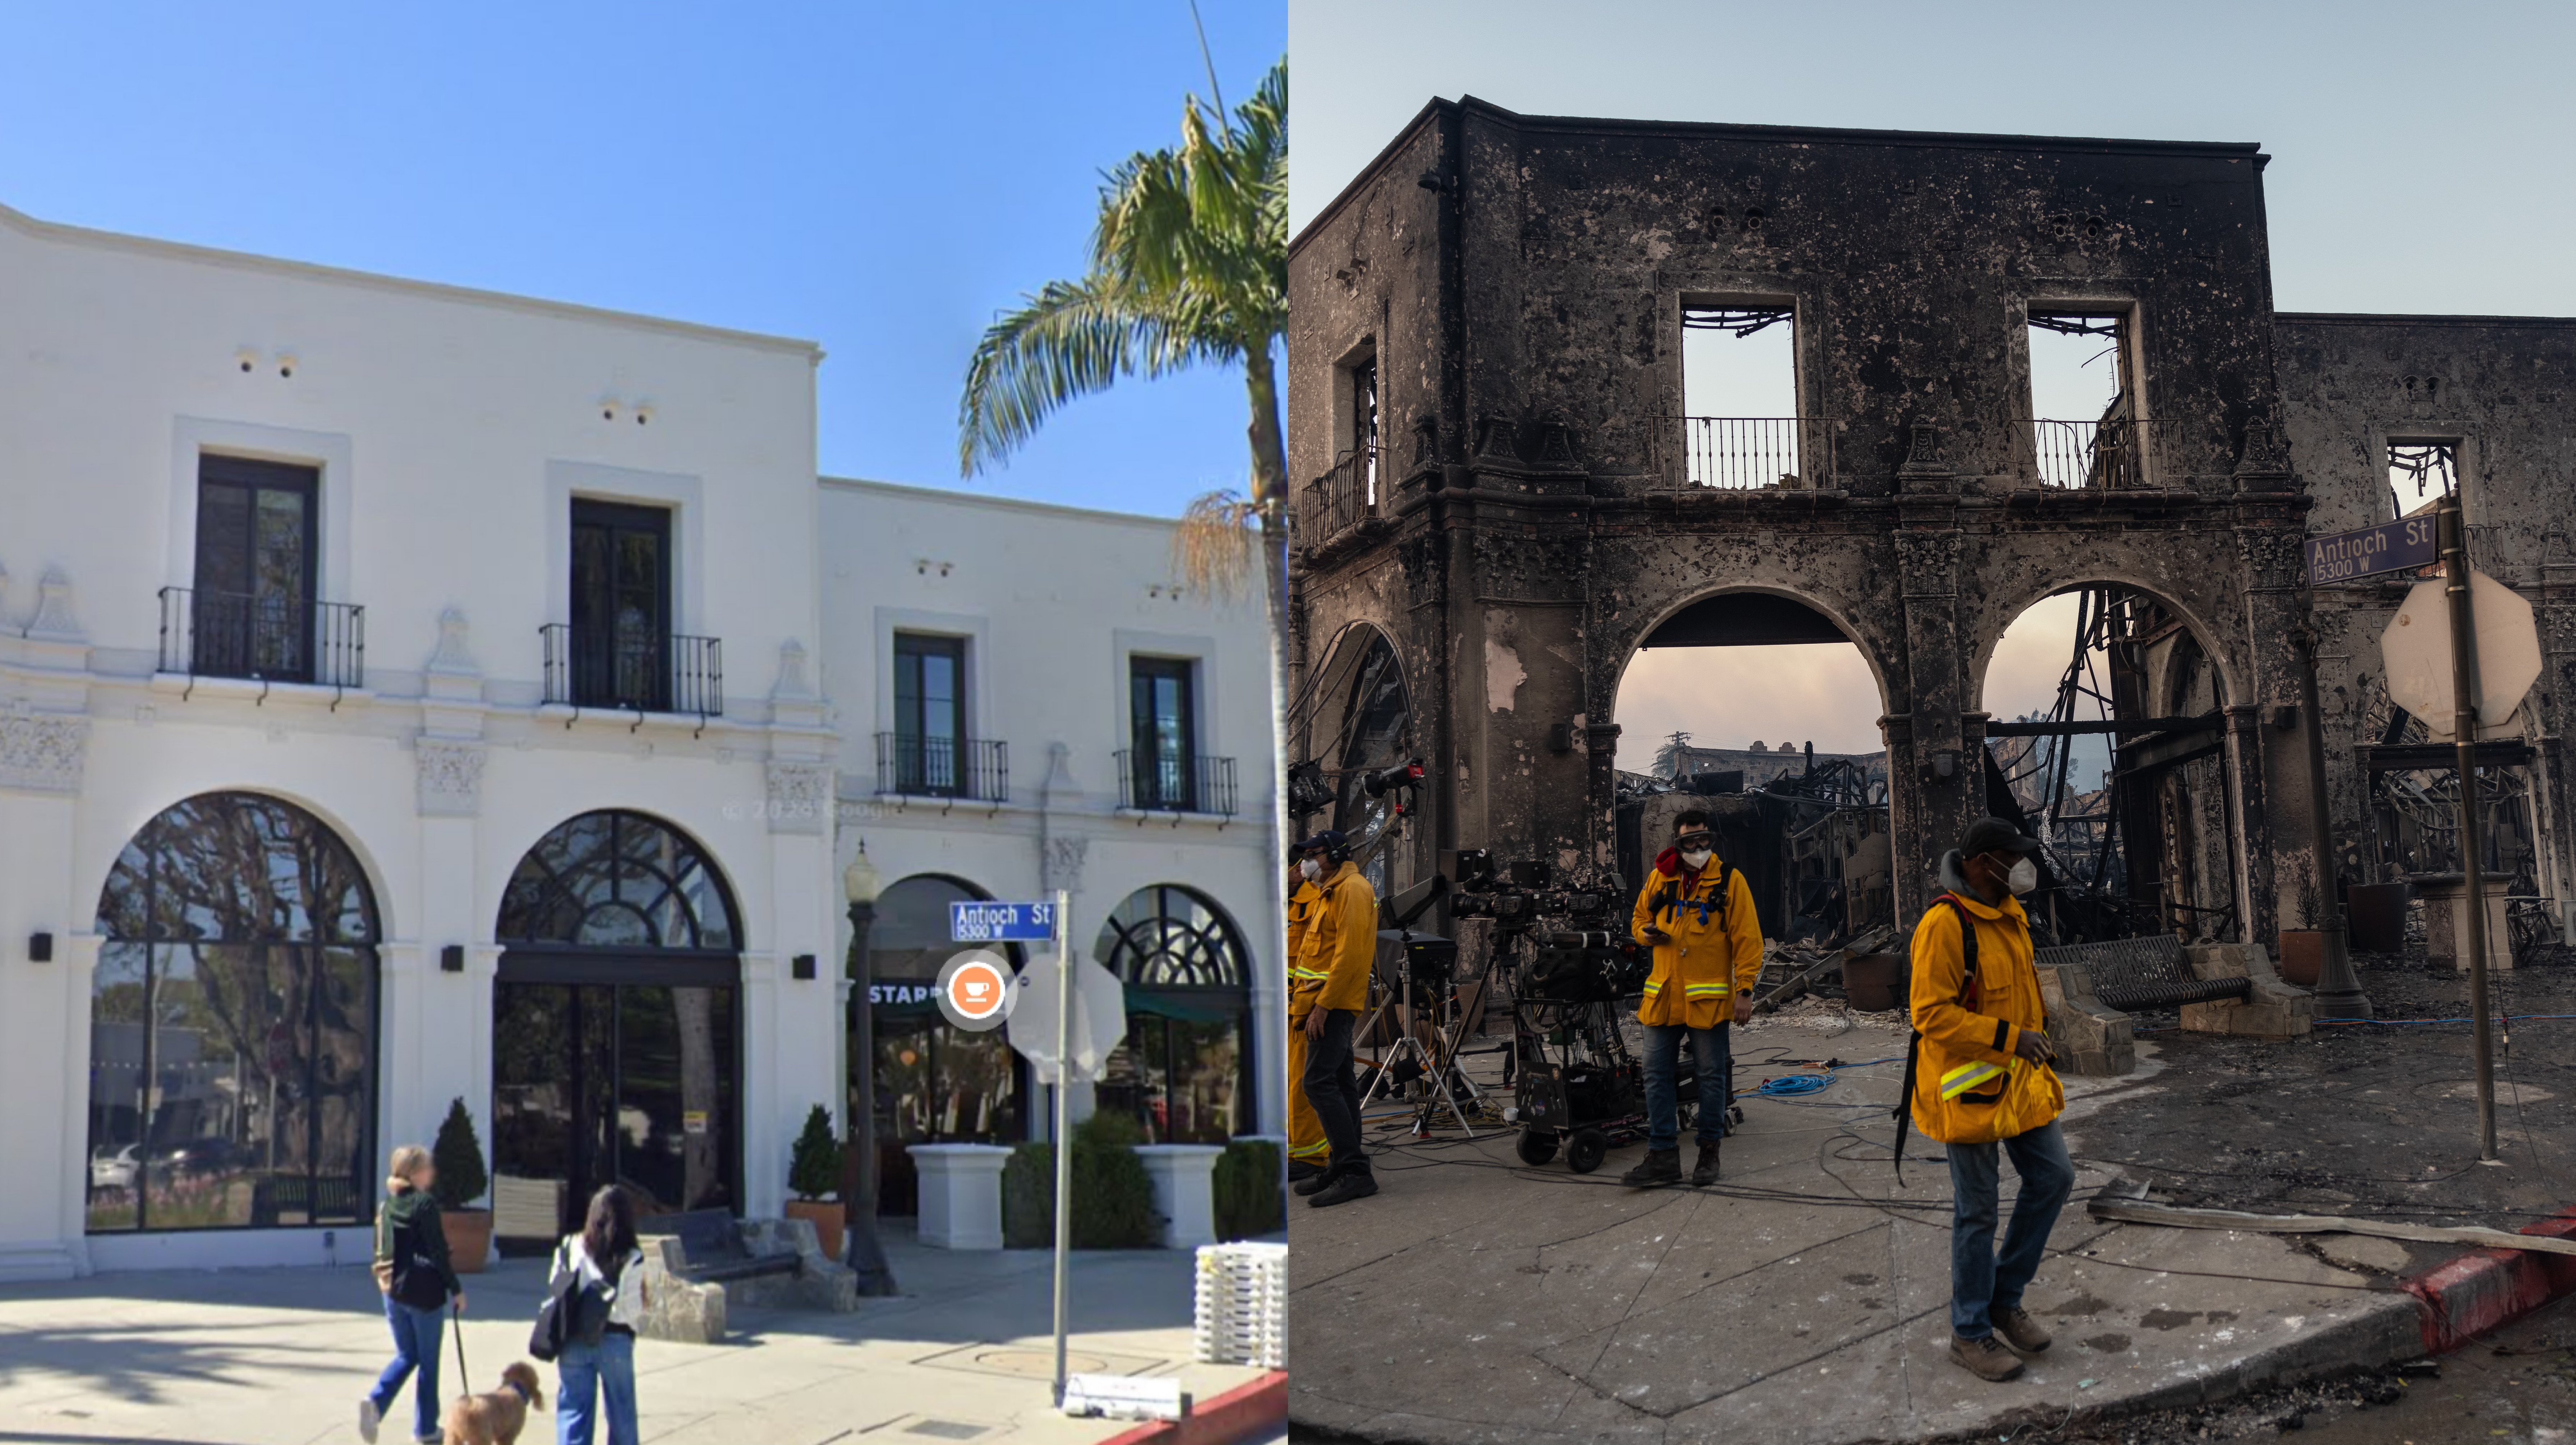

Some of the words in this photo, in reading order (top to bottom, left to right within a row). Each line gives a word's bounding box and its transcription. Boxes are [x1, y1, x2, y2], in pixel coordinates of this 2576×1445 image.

[2313, 529, 2387, 565] Antioch
[2406, 519, 2428, 546] St
[2314, 559, 2353, 581] 15300
[2359, 556, 2369, 572] W
[957, 903, 1018, 925] Antioch
[1031, 903, 1050, 925] St
